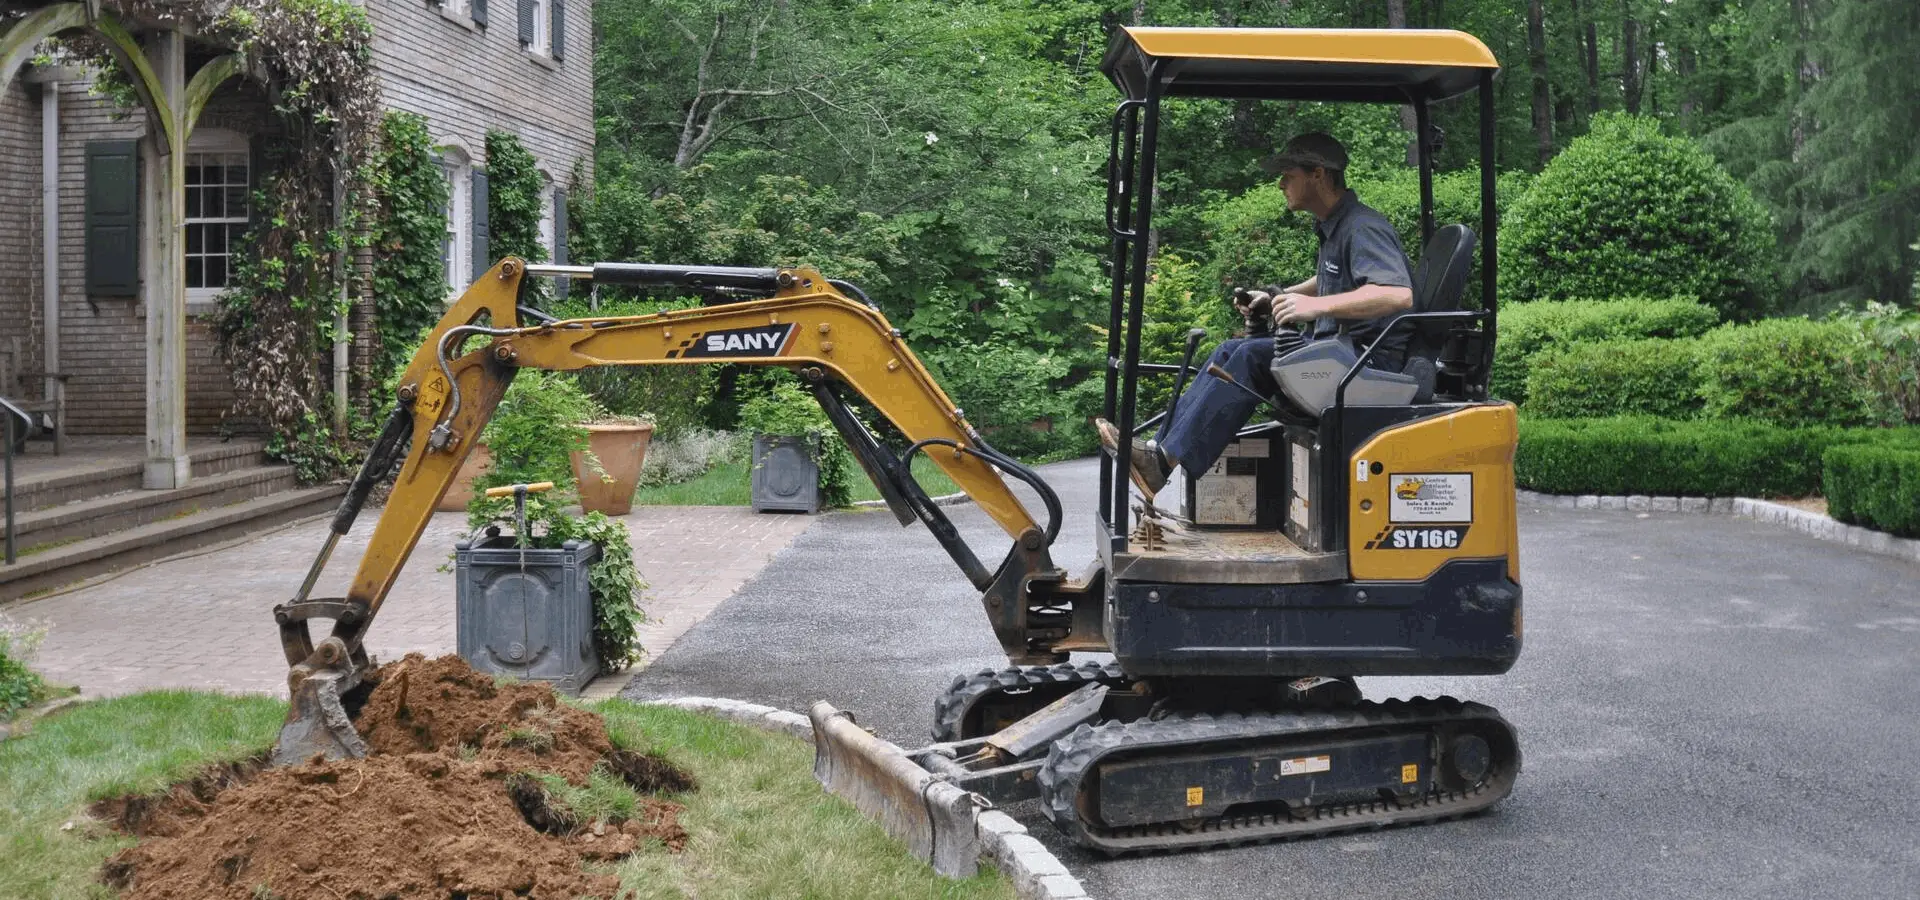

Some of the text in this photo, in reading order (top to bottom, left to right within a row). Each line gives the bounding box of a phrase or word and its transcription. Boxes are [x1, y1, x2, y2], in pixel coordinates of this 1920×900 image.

[707, 332, 781, 352] SANY
[1300, 371, 1332, 379] SANY
[1393, 529, 1457, 549] SY16C
